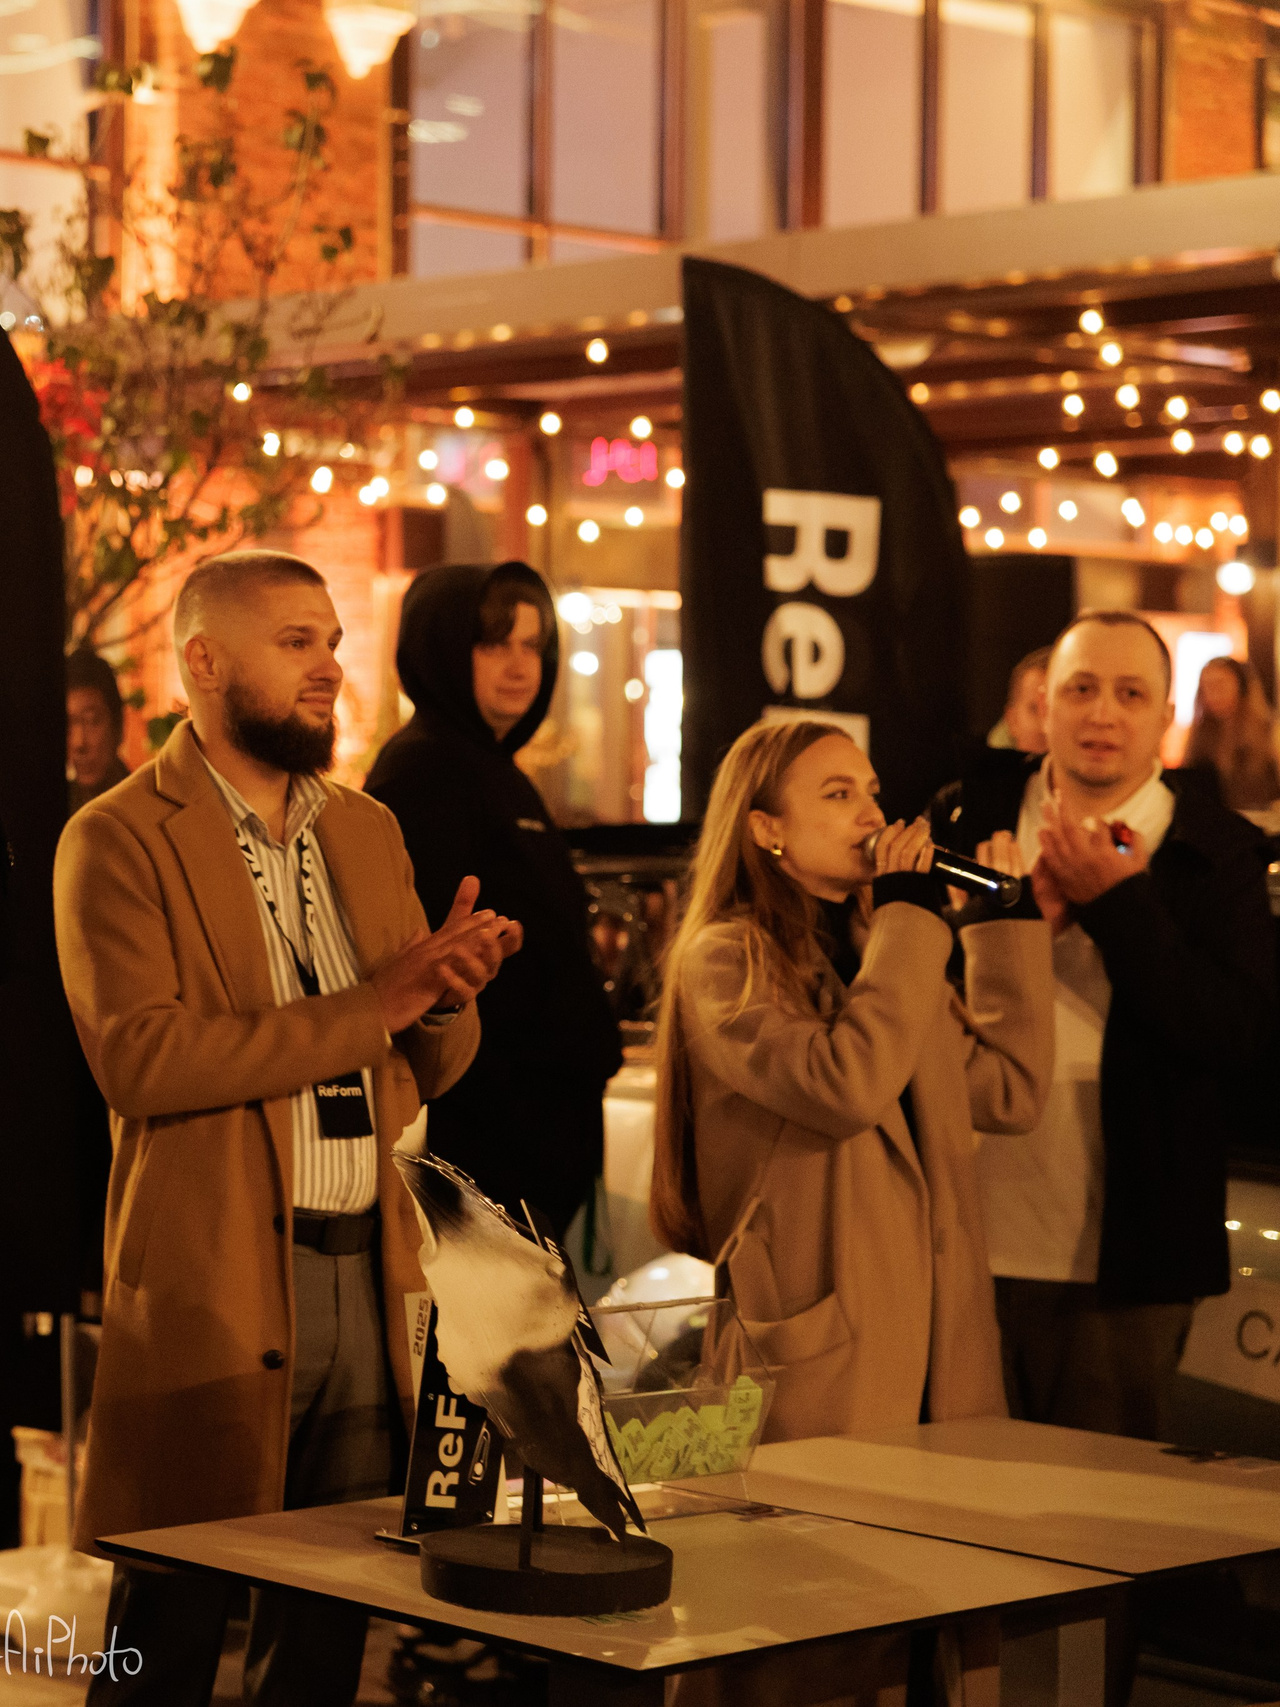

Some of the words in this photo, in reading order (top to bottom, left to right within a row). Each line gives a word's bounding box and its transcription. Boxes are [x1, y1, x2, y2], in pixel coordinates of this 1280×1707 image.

[317, 1084, 363, 1098] ReForm
[413, 1297, 430, 1357] 2025
[425, 1377, 467, 1509] ReF
